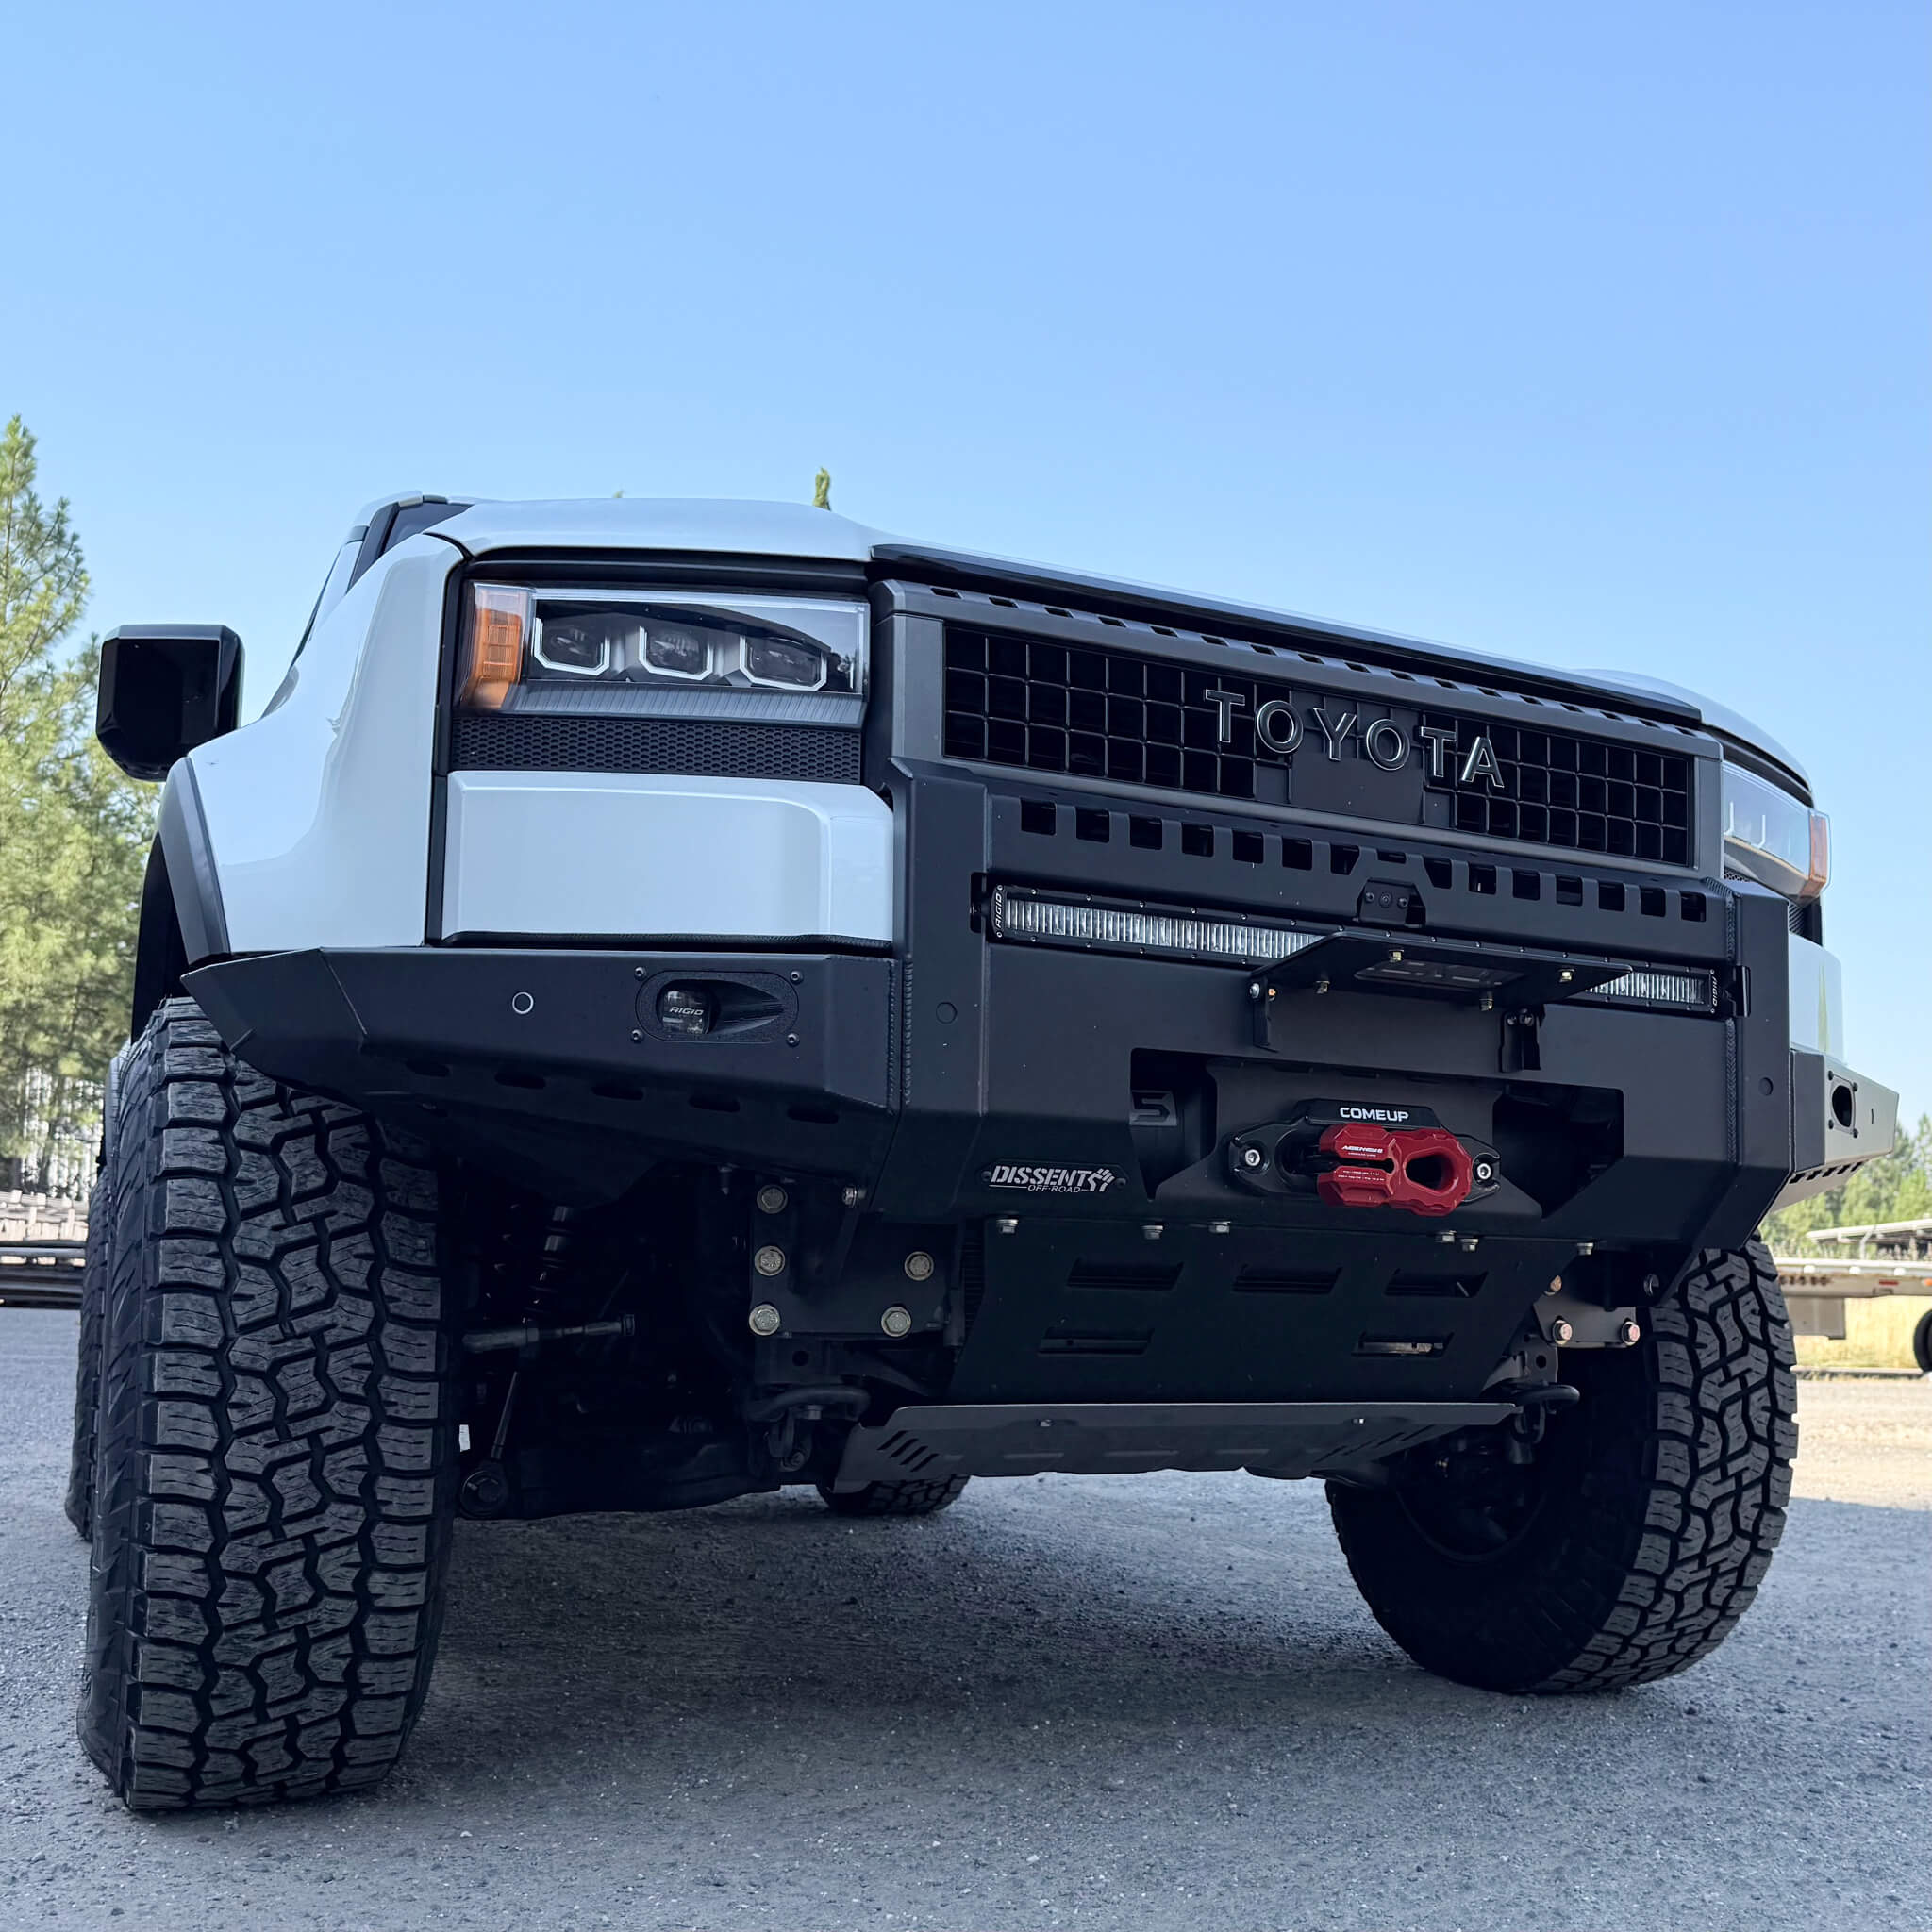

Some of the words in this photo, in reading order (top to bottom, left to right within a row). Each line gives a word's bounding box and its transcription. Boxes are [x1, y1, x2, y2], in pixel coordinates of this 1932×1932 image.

[1206, 689, 1505, 788] TOYOTA
[669, 1006, 704, 1016] RIGID
[1340, 1107, 1409, 1123] COMEUP
[991, 1165, 1092, 1187] DISSENT
